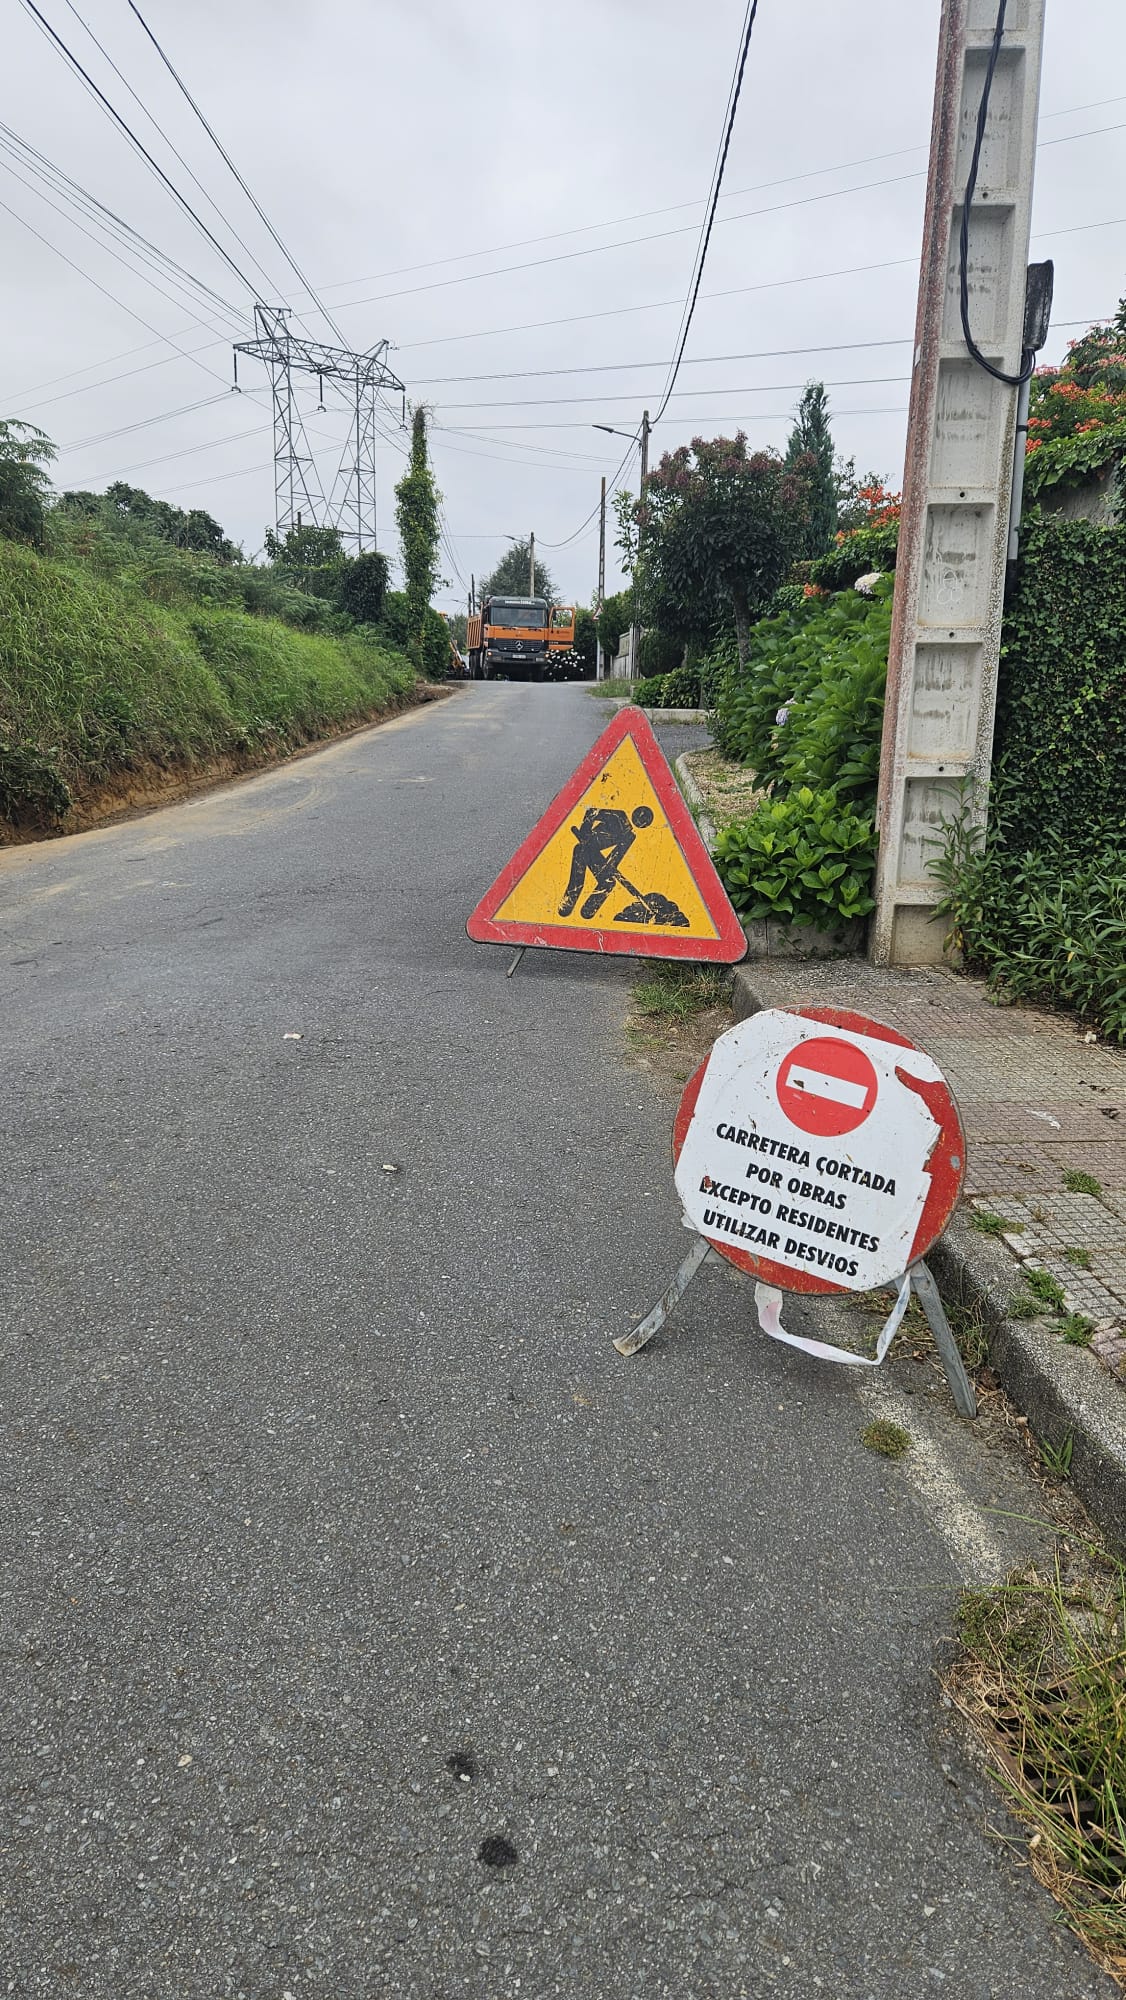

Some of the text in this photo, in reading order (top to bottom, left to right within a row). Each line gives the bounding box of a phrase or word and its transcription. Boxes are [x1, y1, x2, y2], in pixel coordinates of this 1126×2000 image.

[716, 1123, 896, 1196] CARRETERA CORTADA
[746, 1163, 847, 1210] POR OBRAS
[703, 1209, 859, 1277] UTILIZAR DESVIOS
[776, 1205, 880, 1252] RESIDENTES
